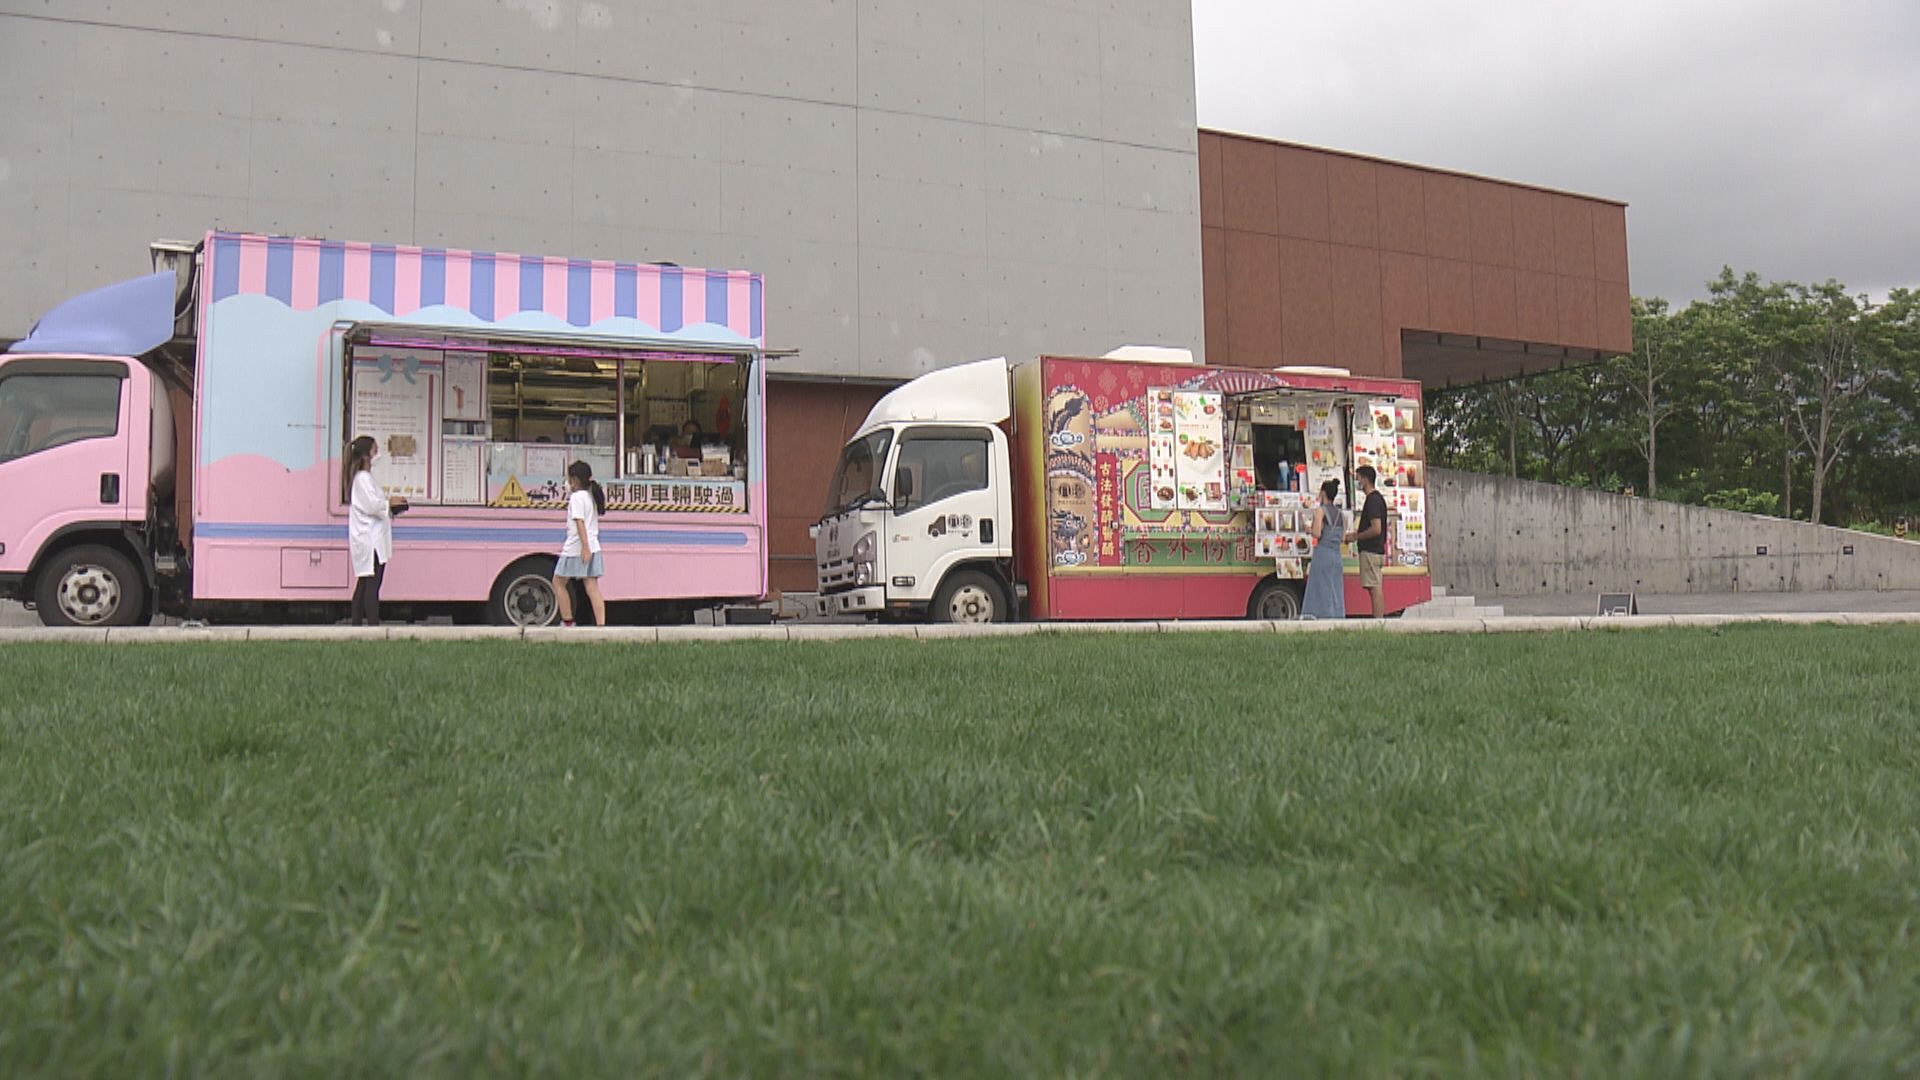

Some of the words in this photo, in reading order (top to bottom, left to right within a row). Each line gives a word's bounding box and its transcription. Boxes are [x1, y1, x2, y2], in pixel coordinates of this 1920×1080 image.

[561, 480, 734, 505] 兩側車輛駛過
